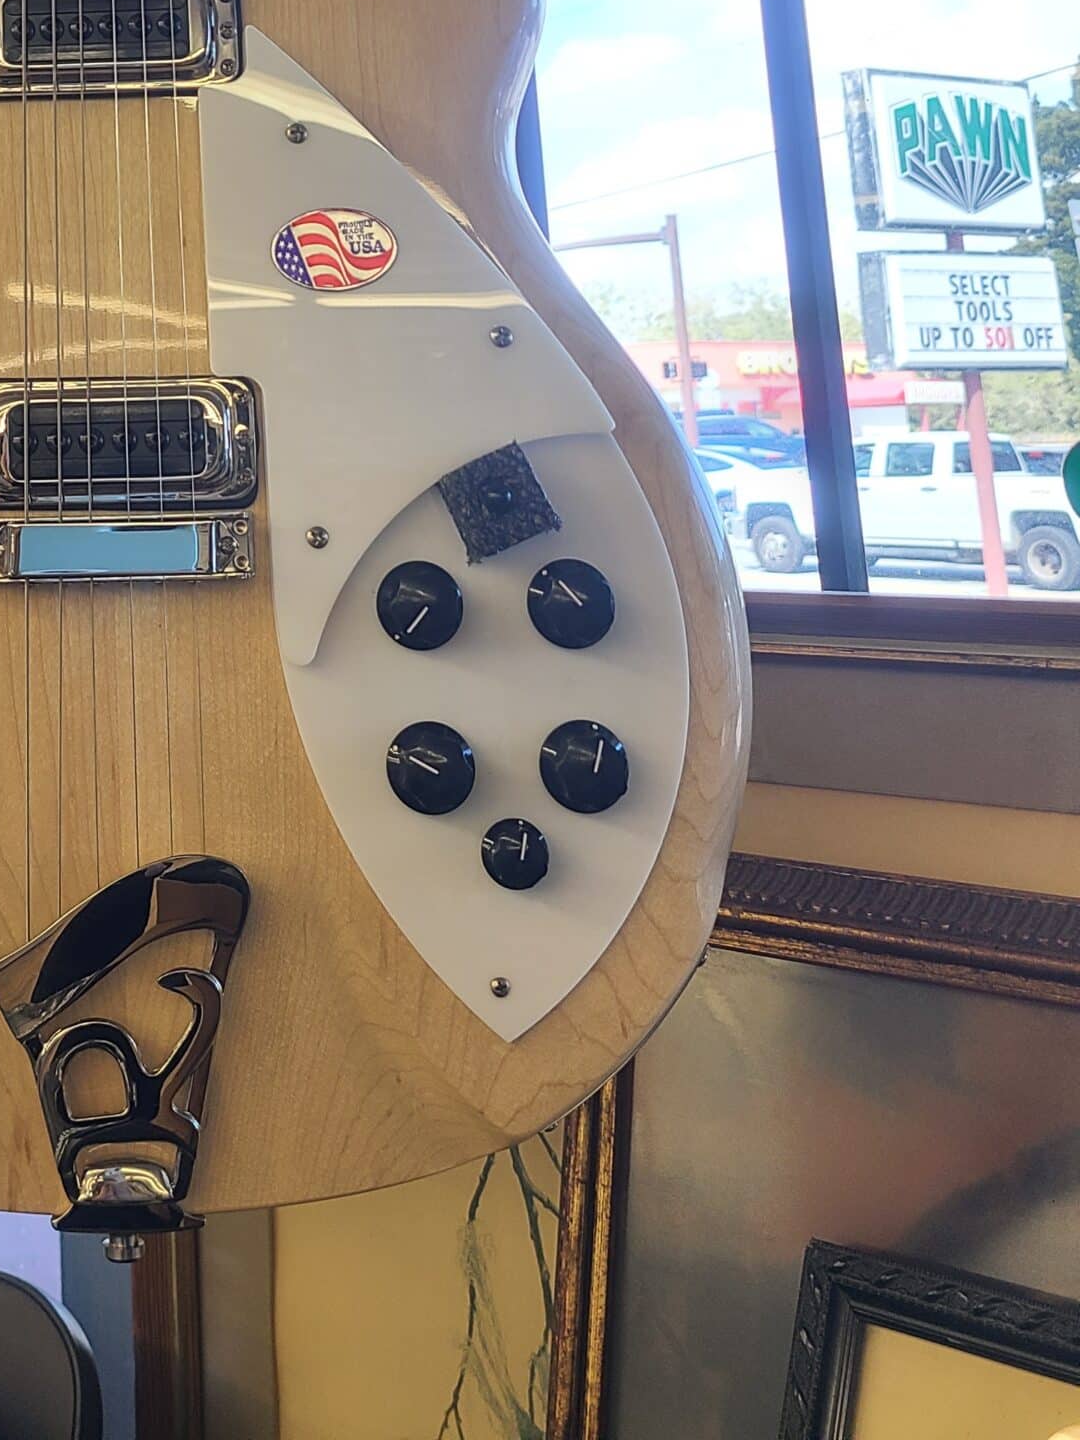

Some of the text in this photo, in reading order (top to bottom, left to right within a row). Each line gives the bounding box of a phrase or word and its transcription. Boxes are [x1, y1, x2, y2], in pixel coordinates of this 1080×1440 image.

[890, 92, 1032, 182] PAWN
[349, 239, 385, 255] USA
[357, 232, 375, 240] THE
[949, 274, 1011, 297] SELECT
[955, 301, 1013, 322] TOOLS
[920, 326, 941, 348] UP
[950, 326, 974, 348] TO
[1024, 327, 1054, 349] OFF
